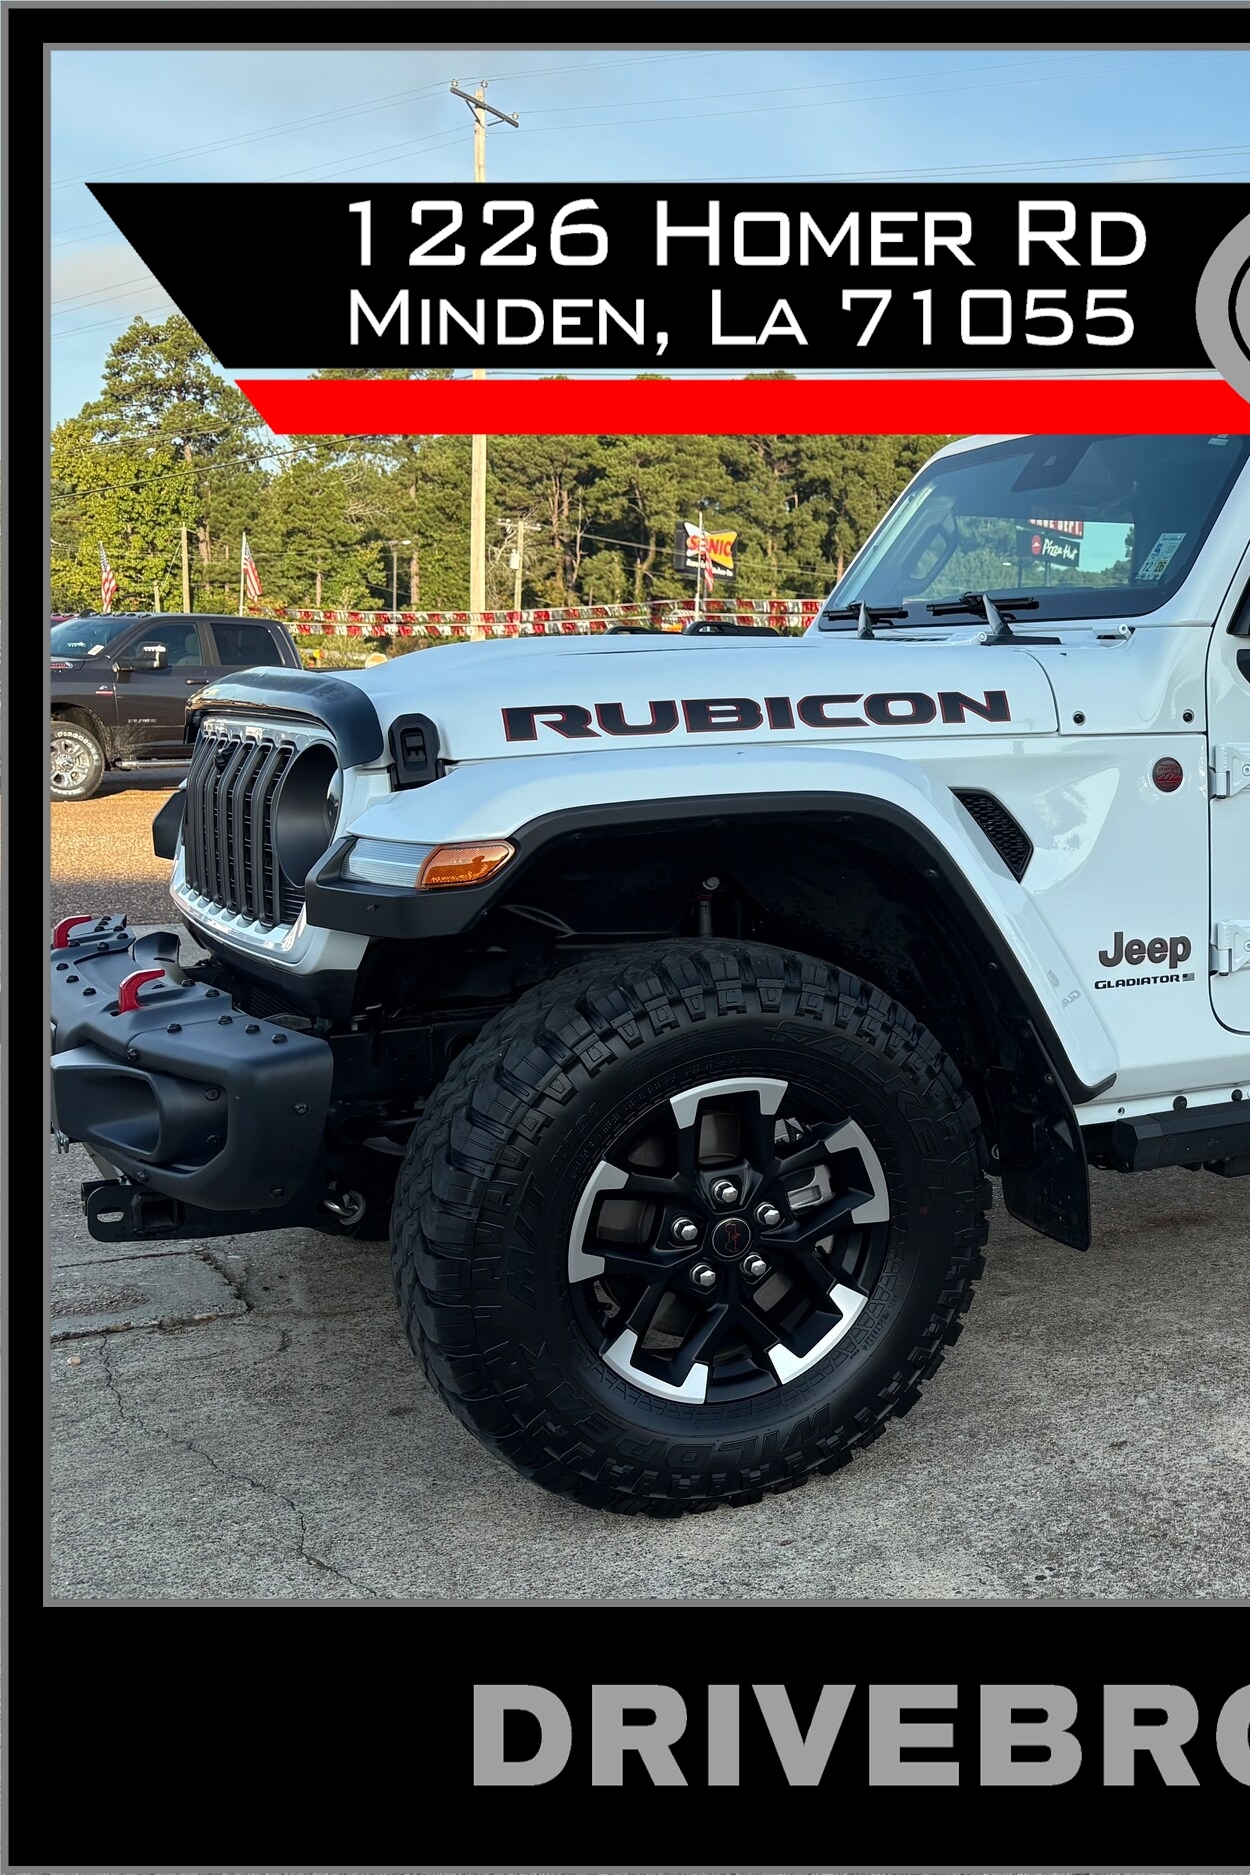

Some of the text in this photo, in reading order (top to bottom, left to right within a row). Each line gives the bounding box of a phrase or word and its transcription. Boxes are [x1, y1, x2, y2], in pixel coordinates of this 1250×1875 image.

[690, 535, 732, 557] SNIC
[1042, 538, 1078, 560] Pizza Hut
[1143, 561, 1154, 572] 12
[501, 690, 1012, 742] RUBICON
[1099, 931, 1192, 969] Jeep
[1095, 974, 1180, 989] GLADIATOR
[763, 1019, 959, 1206] FALKEN
[494, 1342, 836, 1467] WILDPEAK
